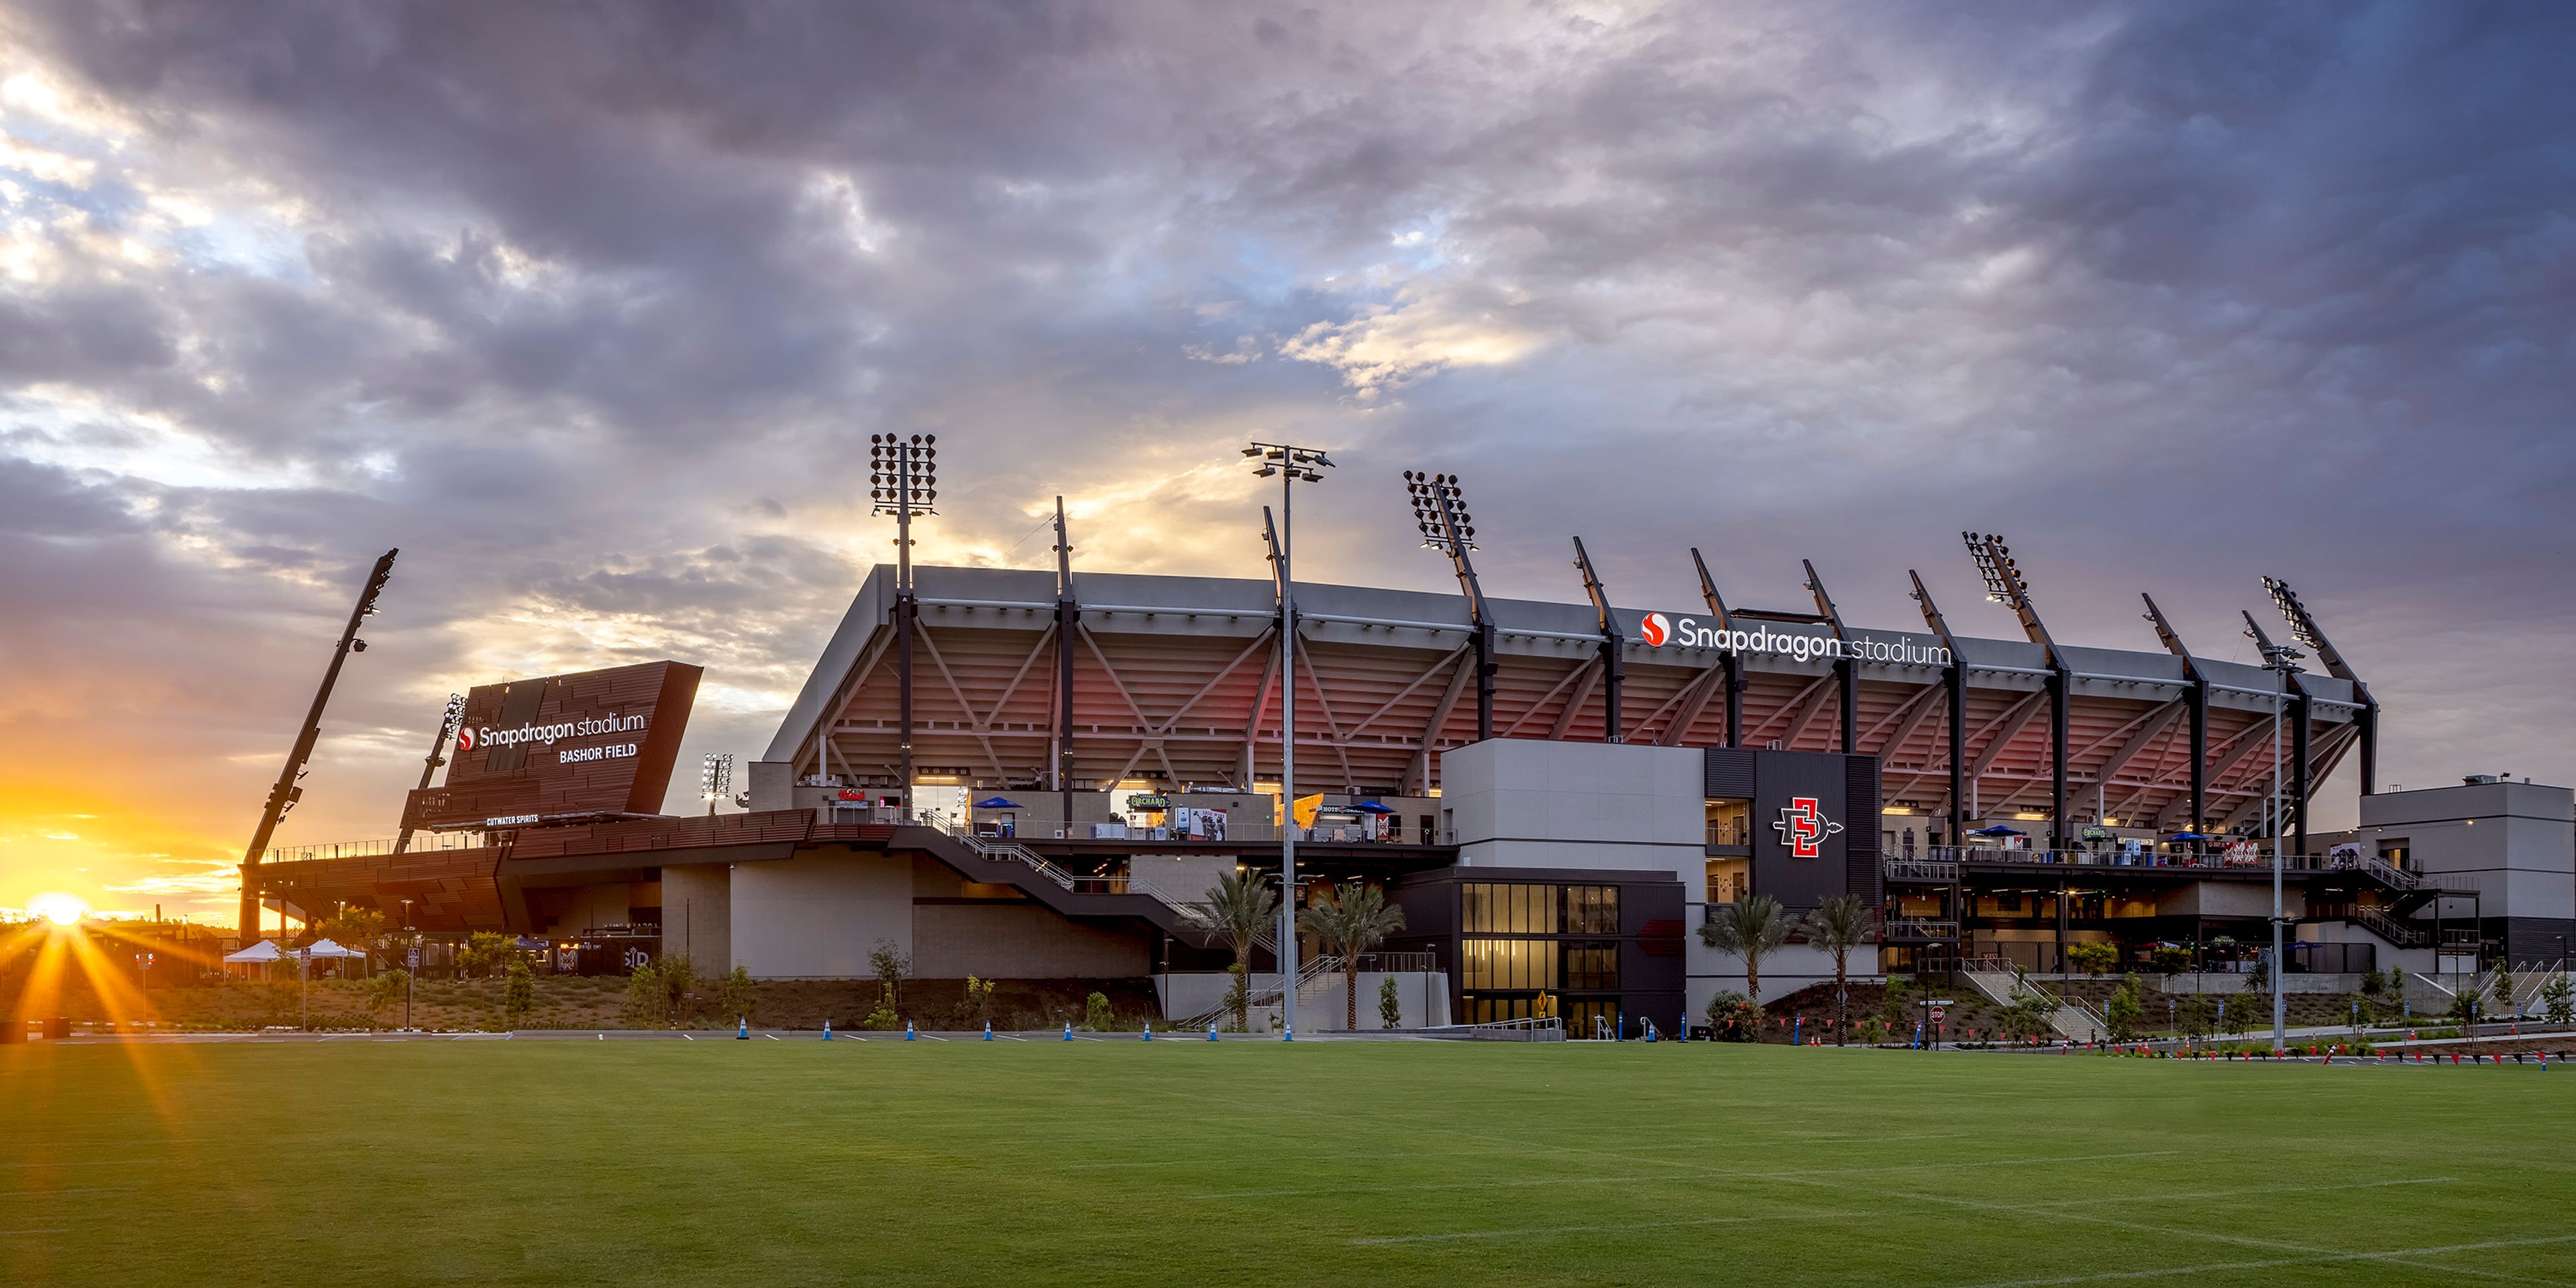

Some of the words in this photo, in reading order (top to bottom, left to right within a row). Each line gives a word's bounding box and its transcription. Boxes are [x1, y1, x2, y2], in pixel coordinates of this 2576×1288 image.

[1678, 618, 1841, 662] Snapdragon
[1851, 636, 1951, 665] stadium
[479, 722, 574, 749] Snapdragon
[577, 712, 644, 736] stadium
[559, 747, 602, 763] BASHOR
[605, 743, 637, 759] FIELD
[1131, 796, 1165, 808] ORCHARD
[486, 816, 516, 826] CUTWATER
[516, 814, 539, 824] SPIRITS
